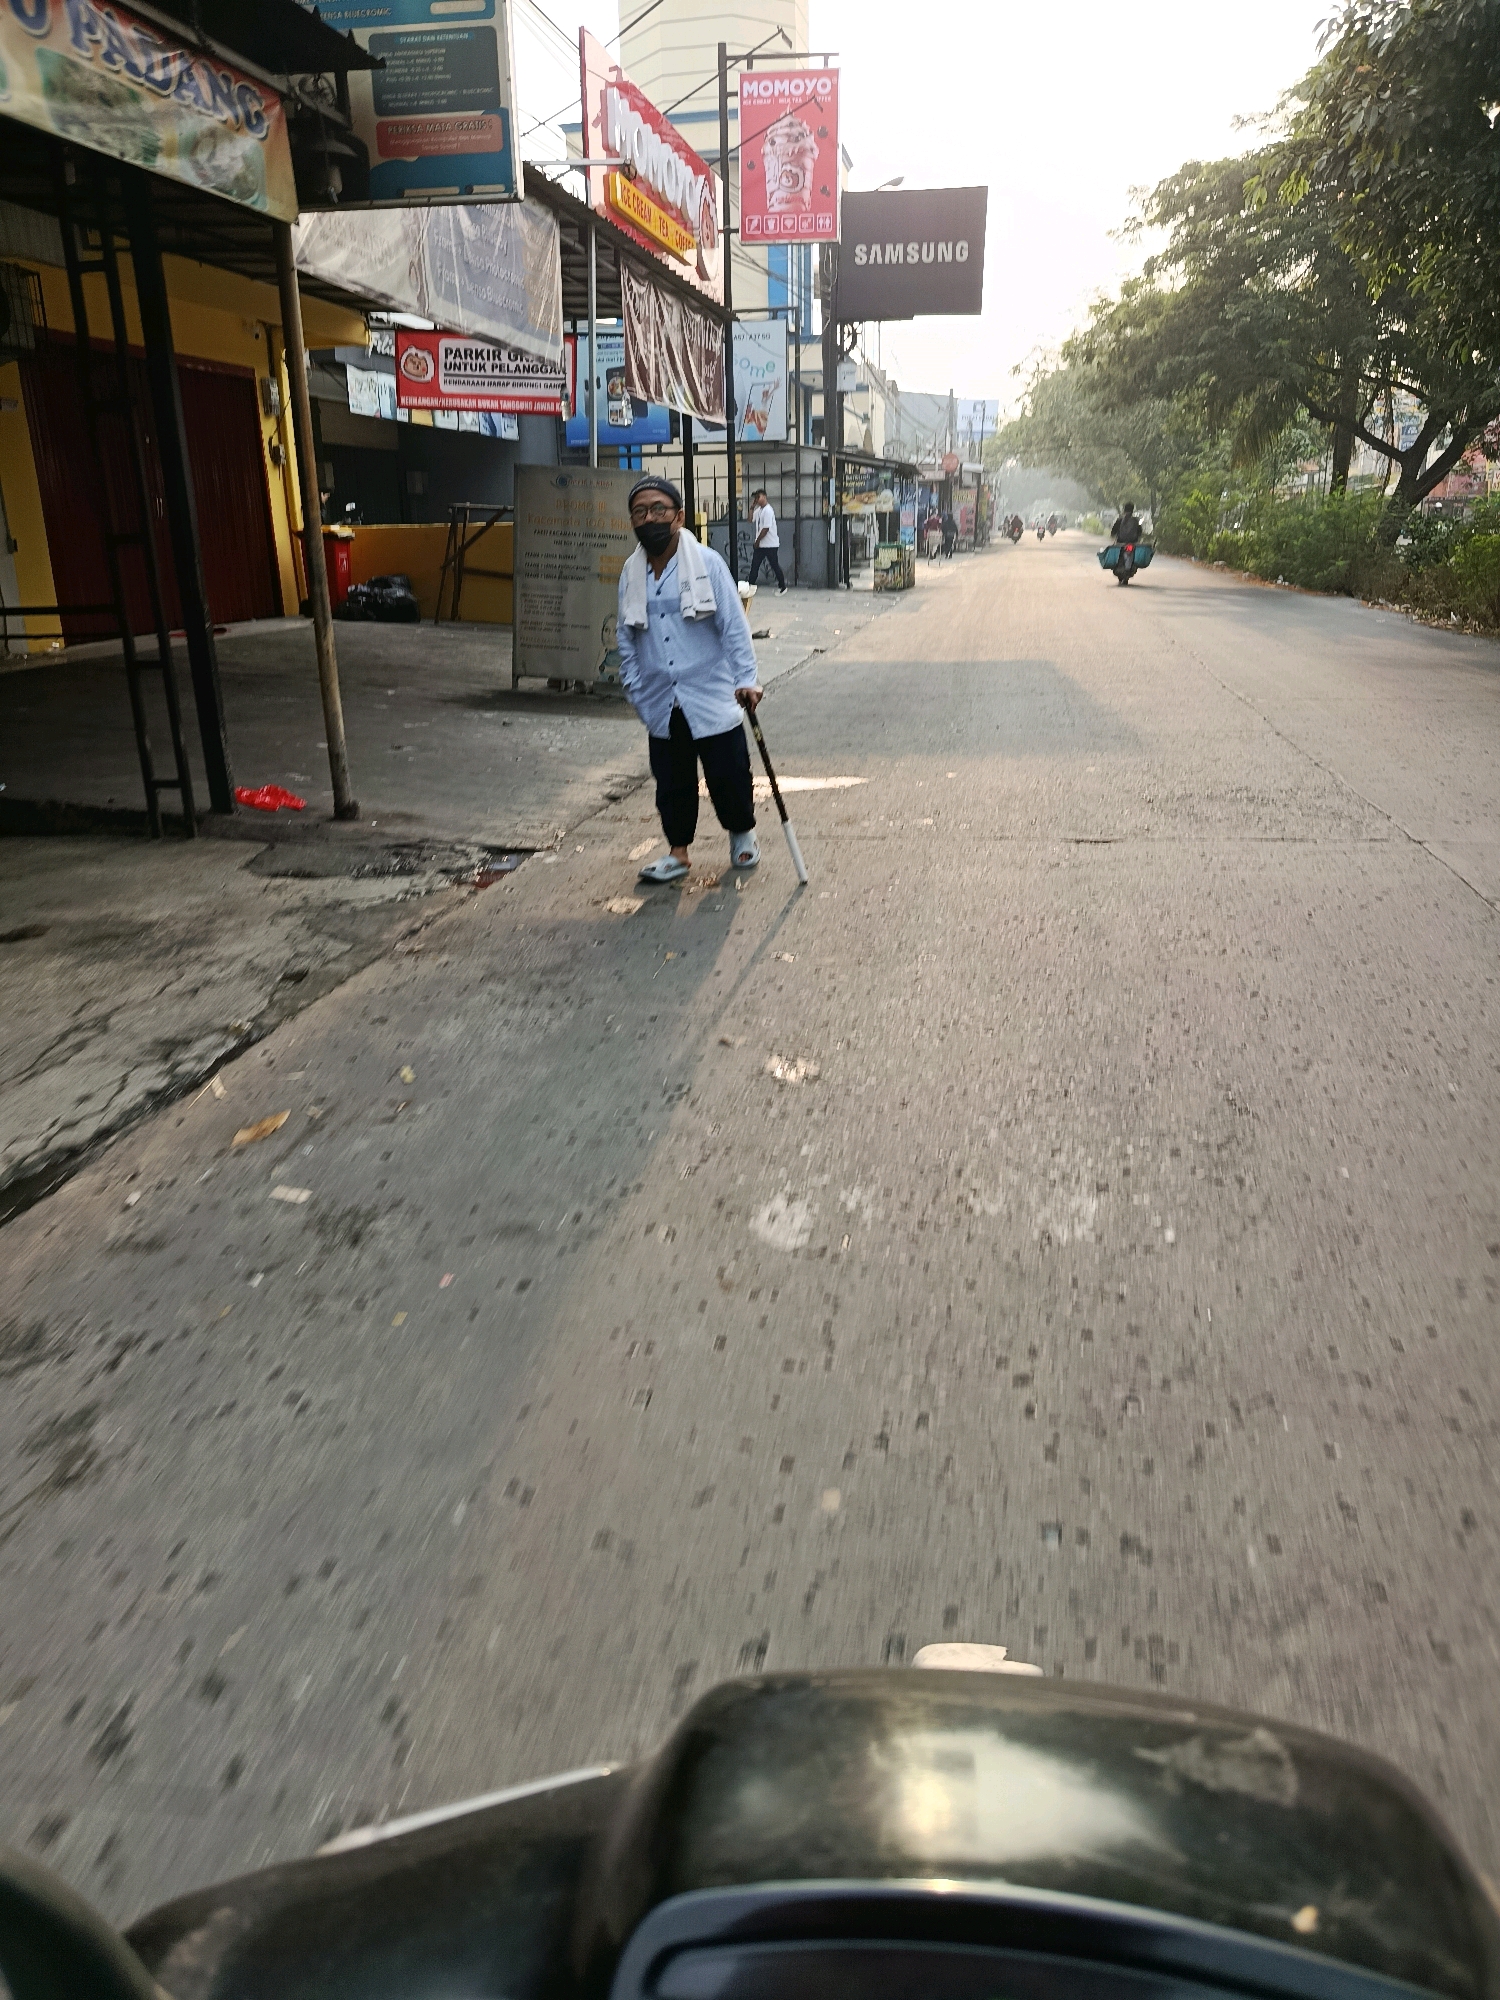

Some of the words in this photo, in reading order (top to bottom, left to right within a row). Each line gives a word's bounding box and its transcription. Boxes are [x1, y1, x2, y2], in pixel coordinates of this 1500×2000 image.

[63, 0, 269, 140] PADANG
[742, 76, 832, 99] MOMOYO
[854, 239, 969, 266] SAMSUNG
[444, 346, 502, 362] PARKIR
[443, 361, 487, 373] UNTUK
